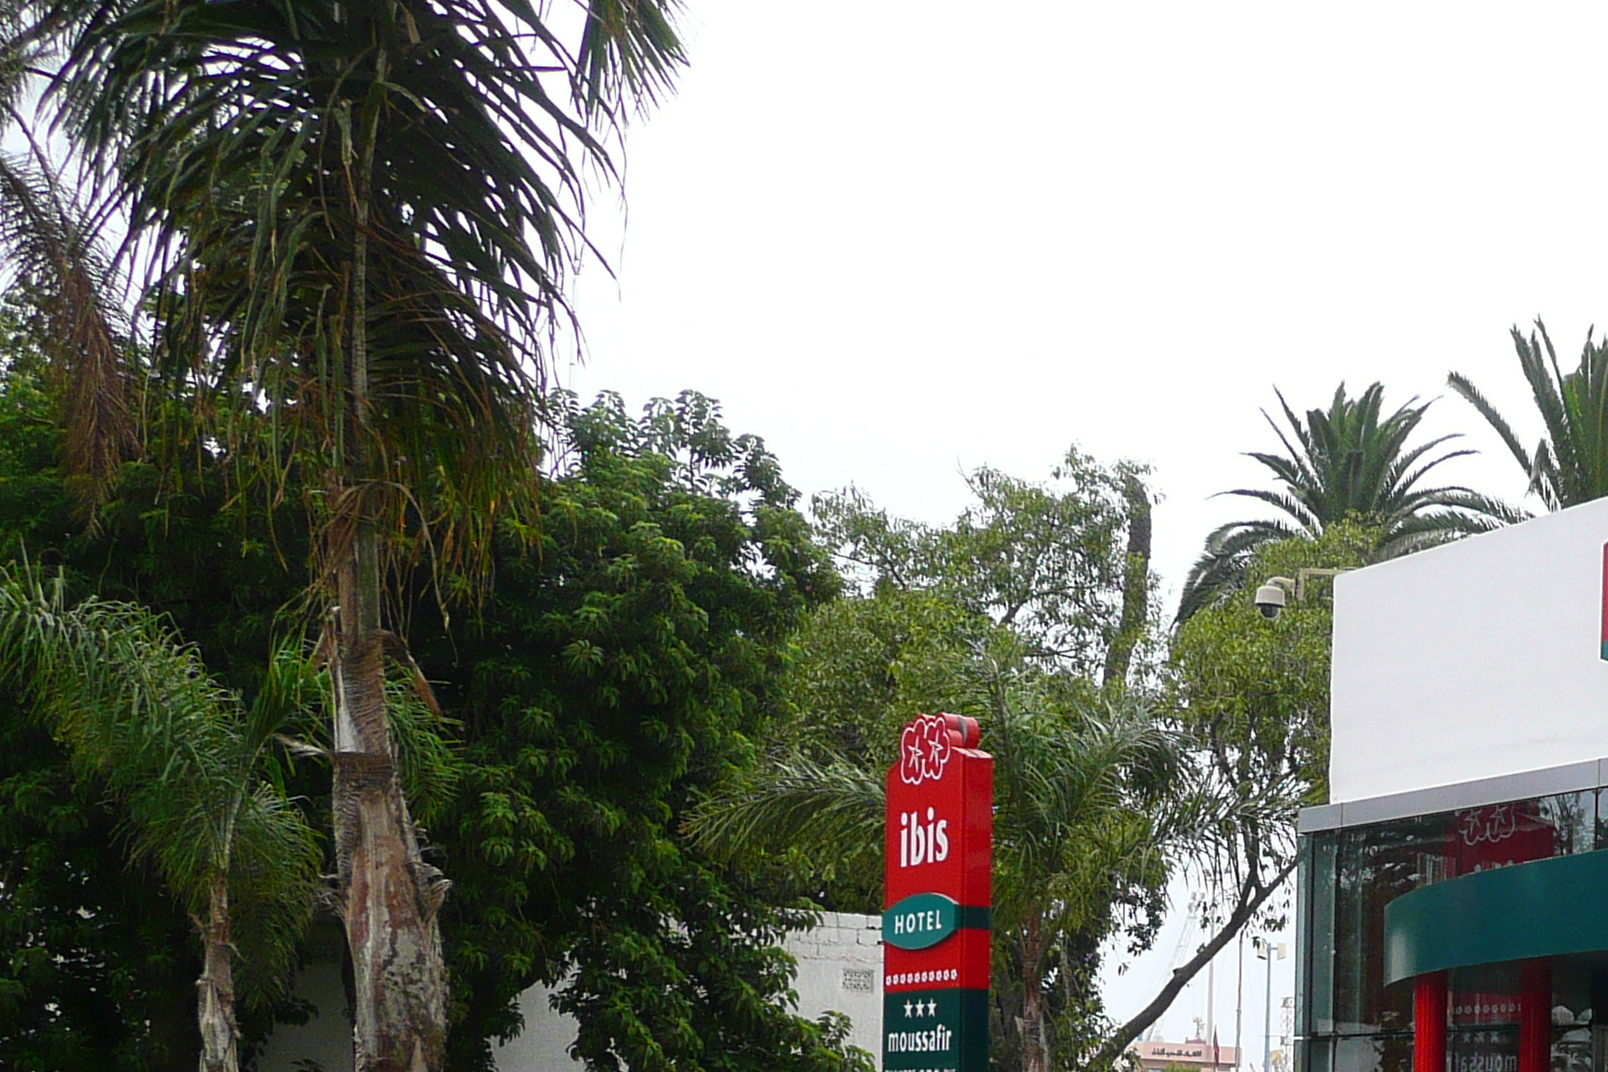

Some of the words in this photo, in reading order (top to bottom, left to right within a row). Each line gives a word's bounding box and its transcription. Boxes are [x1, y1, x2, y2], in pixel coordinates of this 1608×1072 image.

[900, 806, 949, 868] ibis
[894, 909, 942, 935] HOTEL
[888, 1023, 952, 1052] moussafir
